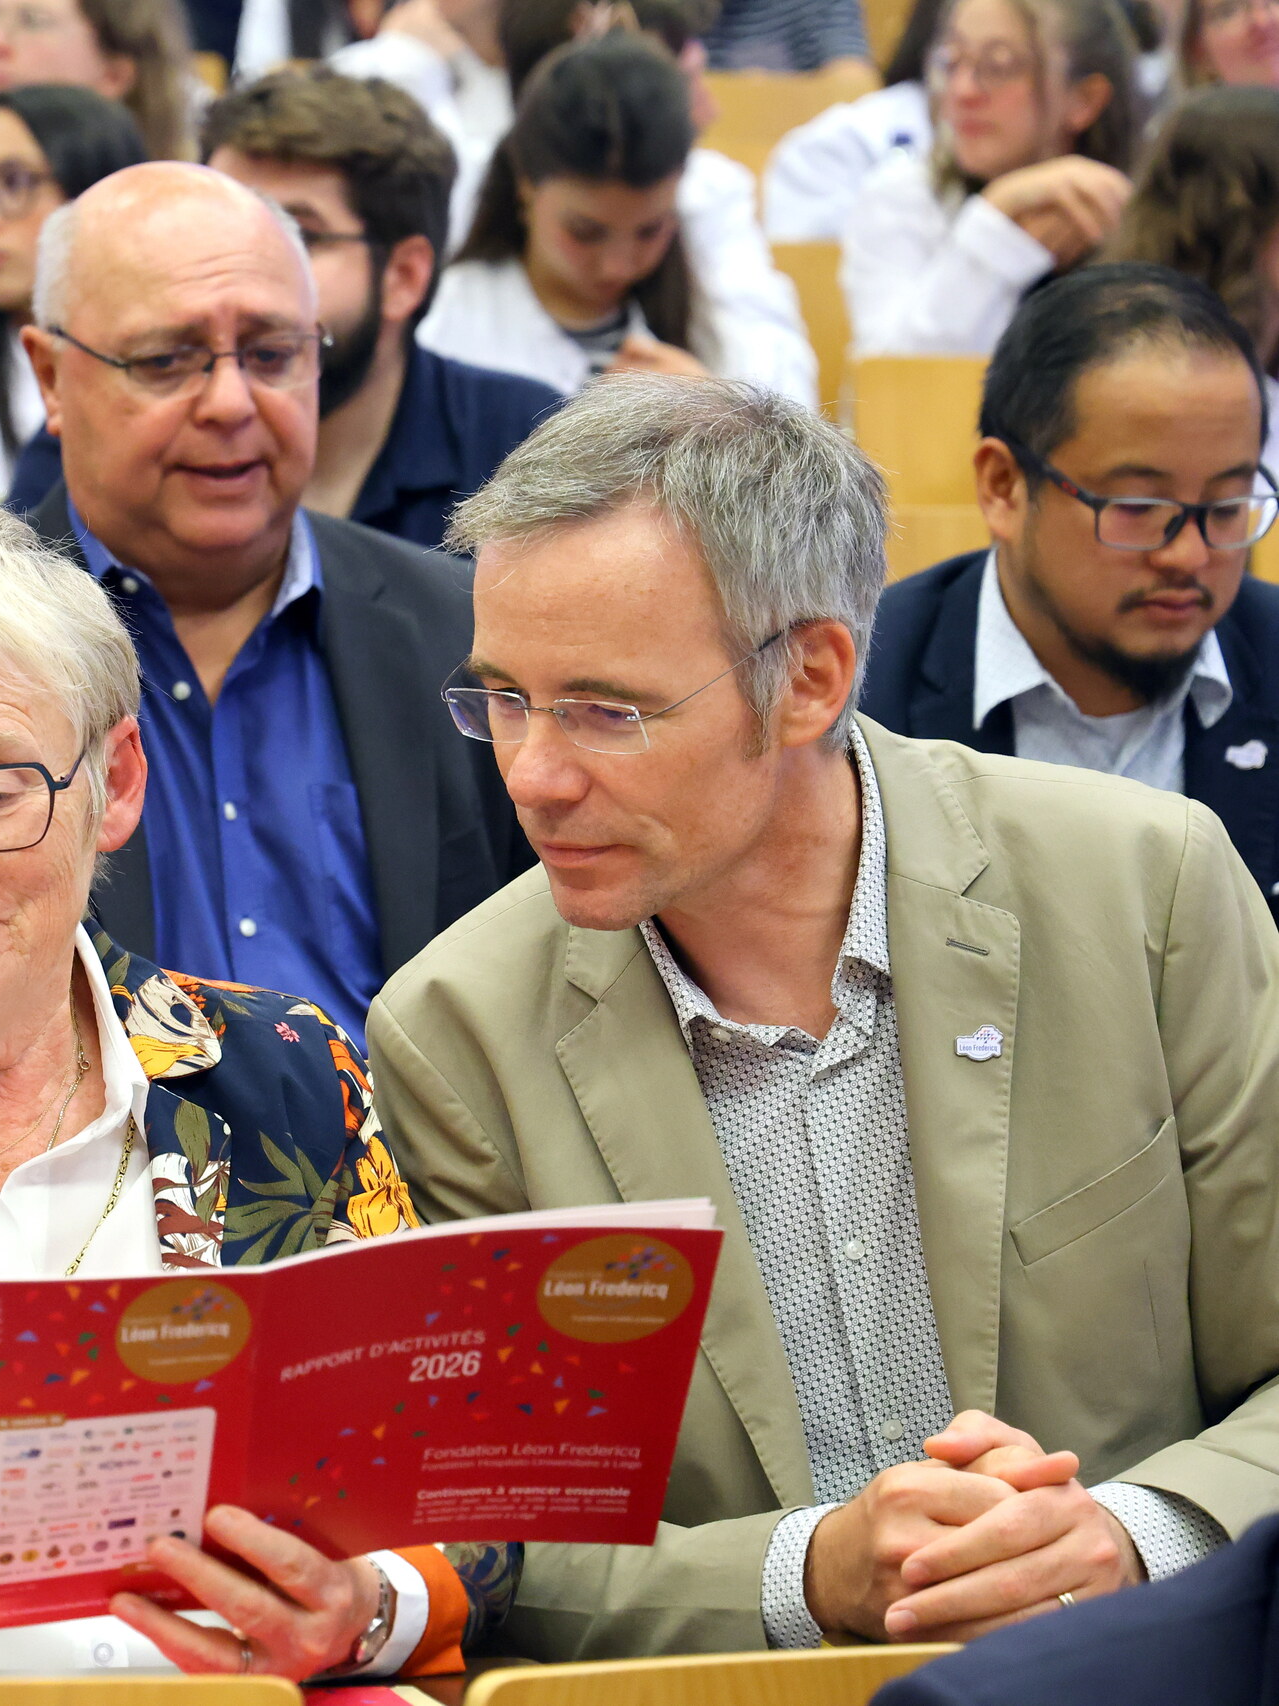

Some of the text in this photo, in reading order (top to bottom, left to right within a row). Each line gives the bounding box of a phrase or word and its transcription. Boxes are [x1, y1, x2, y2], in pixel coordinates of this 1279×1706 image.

[959, 1044, 998, 1053] Léon Fredericq
[543, 1279, 670, 1300] Léon Fredericq
[280, 1330, 486, 1383] RAPPORT D'ACTIVITÉS
[409, 1350, 483, 1383] 2026
[424, 1443, 641, 1460] Fondation Léon Fredericq
[565, 1486, 631, 1497] ensemble
